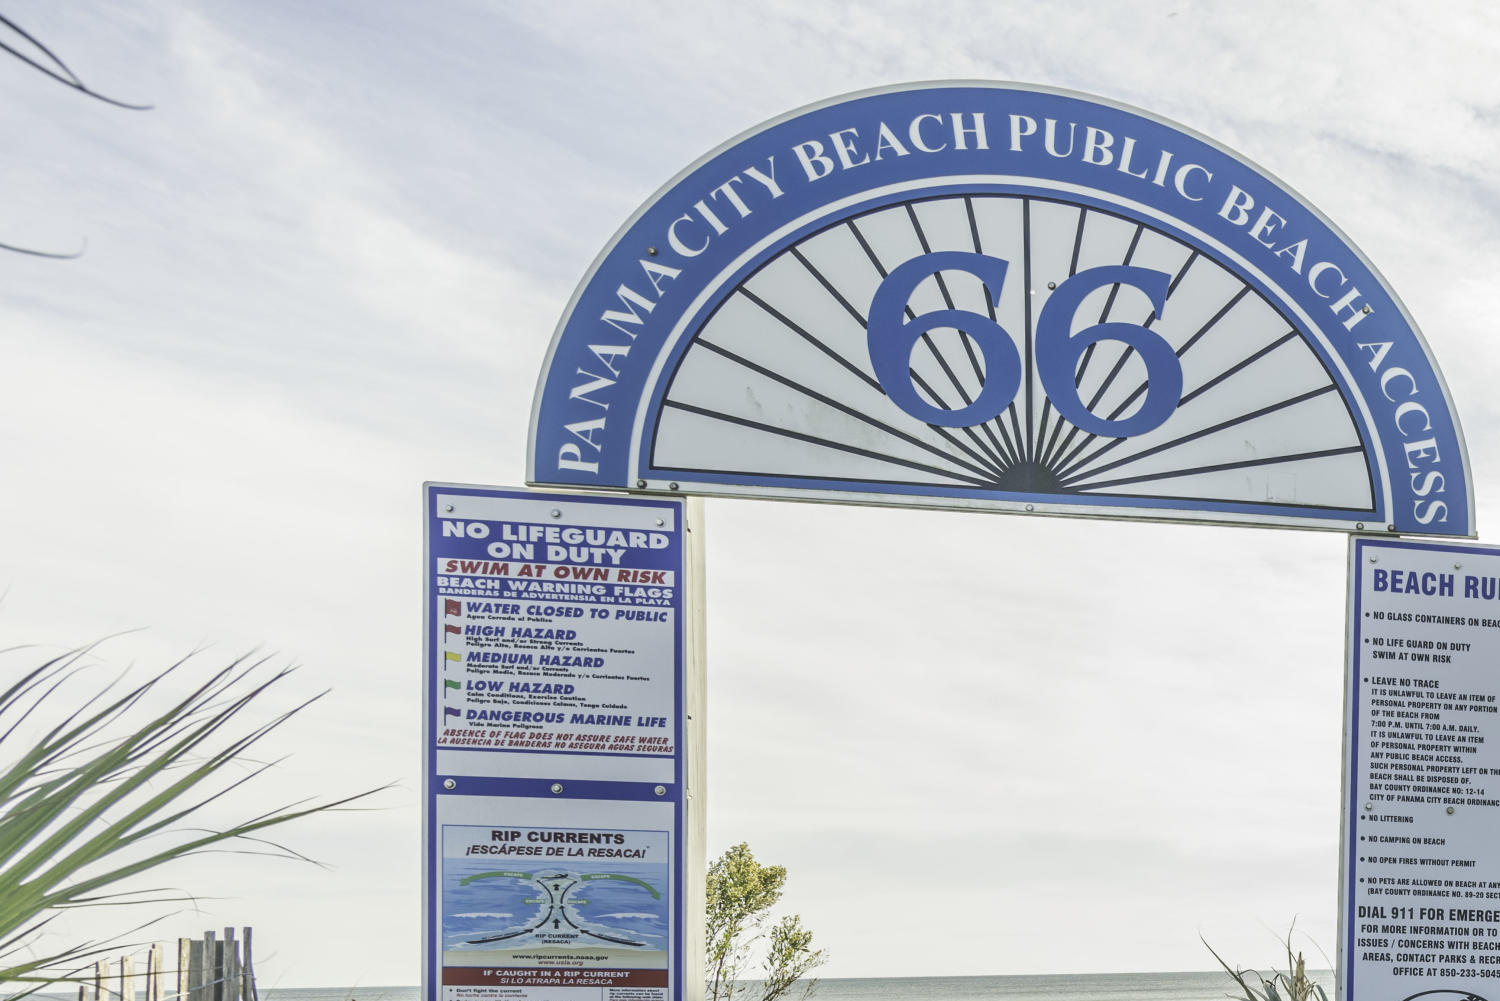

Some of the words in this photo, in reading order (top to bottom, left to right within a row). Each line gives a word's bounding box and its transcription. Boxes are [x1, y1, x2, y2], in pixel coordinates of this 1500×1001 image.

[558, 259, 682, 475] PANAMA
[667, 155, 785, 257] CITY
[792, 112, 990, 182] BEACH
[1009, 114, 1213, 201] PUBLIC
[1217, 185, 1374, 332] BEACH
[1357, 341, 1448, 525] ACCESS
[867, 250, 1184, 437] 66
[443, 521, 490, 539] NO
[503, 525, 669, 549] LIFEGUARD
[488, 543, 534, 560] ON
[548, 545, 626, 565] DUTY
[446, 560, 509, 576] SWIM
[518, 564, 547, 578] AT
[554, 566, 610, 581] OWN
[617, 570, 666, 584] RISK
[437, 577, 499, 589] BEACH
[508, 581, 606, 595] WARNING
[615, 587, 673, 599] FLAGS
[1374, 569, 1454, 597] BEACH
[522, 592, 597, 602] ADVERTENSIA
[467, 602, 521, 615] WATER
[527, 605, 584, 618] CLOSED
[590, 609, 610, 619] TO
[616, 610, 668, 623] PUBLIC
[1374, 612, 1385, 620] NO
[1388, 612, 1413, 622] GLASS
[1415, 615, 1466, 626] CONTAINERS
[1468, 618, 1479, 627] ON
[465, 625, 505, 638] HIGH
[511, 628, 577, 640] HAZARD
[1373, 638, 1384, 646] NO
[1387, 639, 1404, 648] LIFE
[1407, 640, 1434, 649] GUARD
[1437, 642, 1448, 650] ON
[1450, 643, 1471, 652] DUTY
[467, 652, 533, 665] MEDIUM
[540, 655, 604, 668] HAZARD
[1373, 651, 1396, 660] SWIM
[1399, 652, 1409, 661] AT
[1411, 653, 1430, 662] OWN
[1433, 655, 1451, 664] RISK
[467, 680, 504, 692] LOW
[509, 682, 575, 695] HAZARD
[1372, 677, 1397, 686] LEAVE
[1400, 679, 1411, 687] NO
[1414, 680, 1439, 689] TRACE
[1372, 699, 1406, 708] PERSONAL
[1408, 701, 1442, 710] PROPERTY
[1470, 705, 1498, 713] PORTION
[466, 710, 565, 724] DANGEROUS
[570, 714, 632, 726] MARINE
[638, 717, 667, 728] LIFE
[444, 729, 487, 738] ABSENCE
[504, 731, 526, 739] FLAG
[529, 732, 554, 740] DOES
[575, 734, 612, 743] ASSURE
[613, 736, 636, 744] SAFE
[639, 737, 669, 745] WATER
[450, 738, 492, 746] AUSENCIA
[508, 740, 553, 748] BANDERAS
[568, 742, 606, 750] ASEGURA
[637, 745, 674, 753] SEGURAS
[492, 831, 521, 842] RIP
[528, 832, 625, 845] CURRENTS
[1380, 836, 1410, 844] CAMPING
[1424, 838, 1445, 846] BEACH
[466, 844, 543, 856] ¡ESCÁPESE
[546, 847, 565, 856] DE
[567, 848, 584, 857] LA
[588, 848, 646, 858] RESACA!
[1359, 906, 1387, 919] DIAL
[1392, 907, 1414, 920] 911
[1420, 908, 1444, 921] FOR
[1362, 925, 1379, 933] FOR
[1382, 925, 1407, 934] MORE
[1410, 926, 1470, 936] INFORMATION
[1473, 928, 1484, 937] OR
[1487, 929, 1498, 937] TO
[1358, 938, 1389, 948] ISSUES
[1398, 940, 1445, 949] CONCERNS
[1448, 941, 1470, 950] WITH
[1473, 942, 1500, 951] BEACH
[1363, 953, 1394, 963] AREAS,
[1397, 953, 1437, 963] CONTACT
[1439, 955, 1467, 964] PARKS
[1470, 955, 1476, 964] &
[1393, 967, 1424, 976] OFFICE
[1427, 968, 1438, 977] AT
[1440, 969, 1500, 978] 850-233-5045
